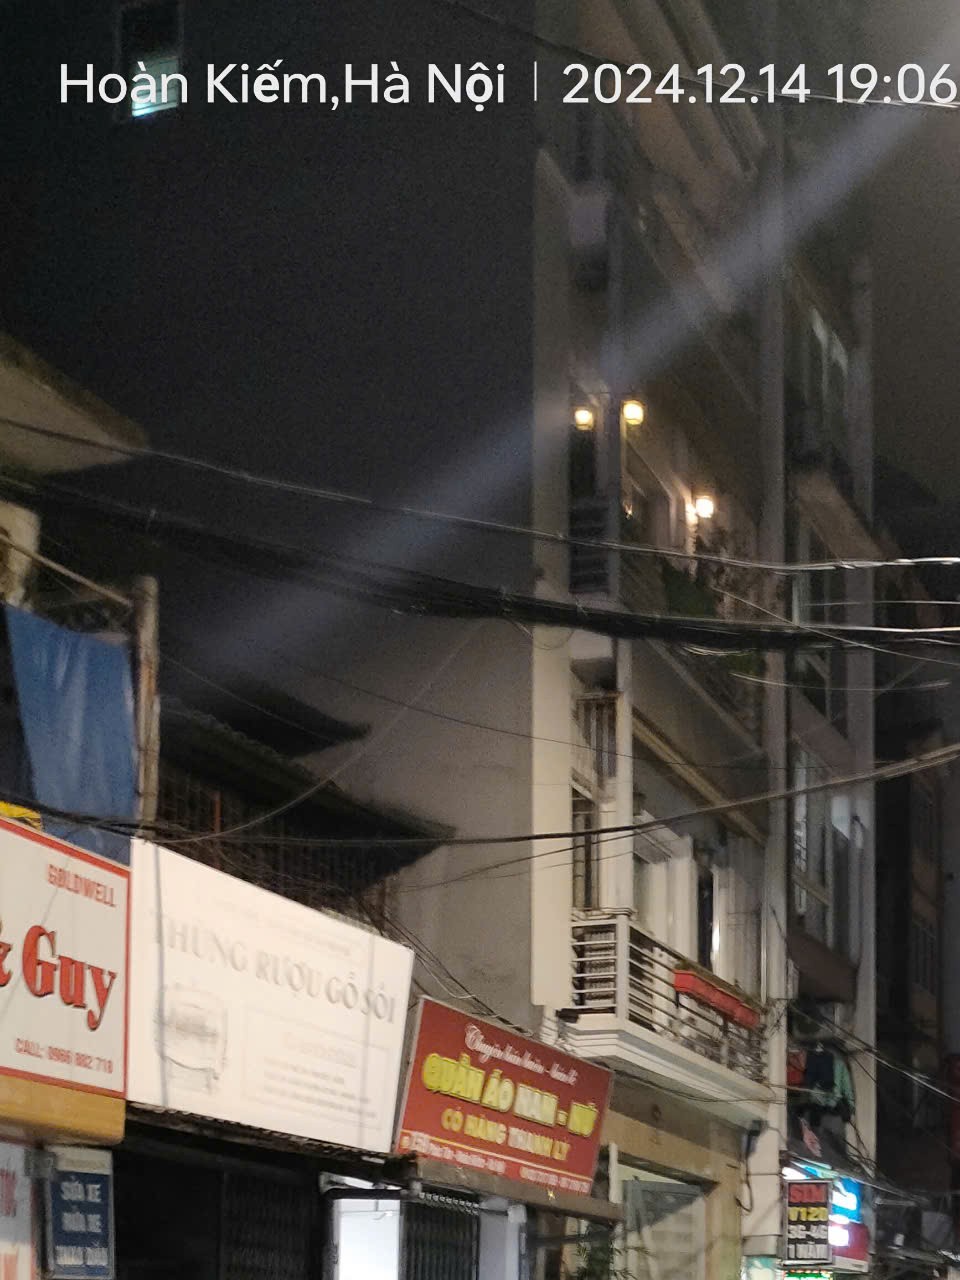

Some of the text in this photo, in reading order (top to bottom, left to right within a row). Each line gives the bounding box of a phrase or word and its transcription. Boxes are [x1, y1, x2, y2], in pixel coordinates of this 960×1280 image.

[48, 864, 116, 907] GOLDWELL
[22, 925, 117, 1031] Guy
[788, 1184, 828, 1203] SIM
